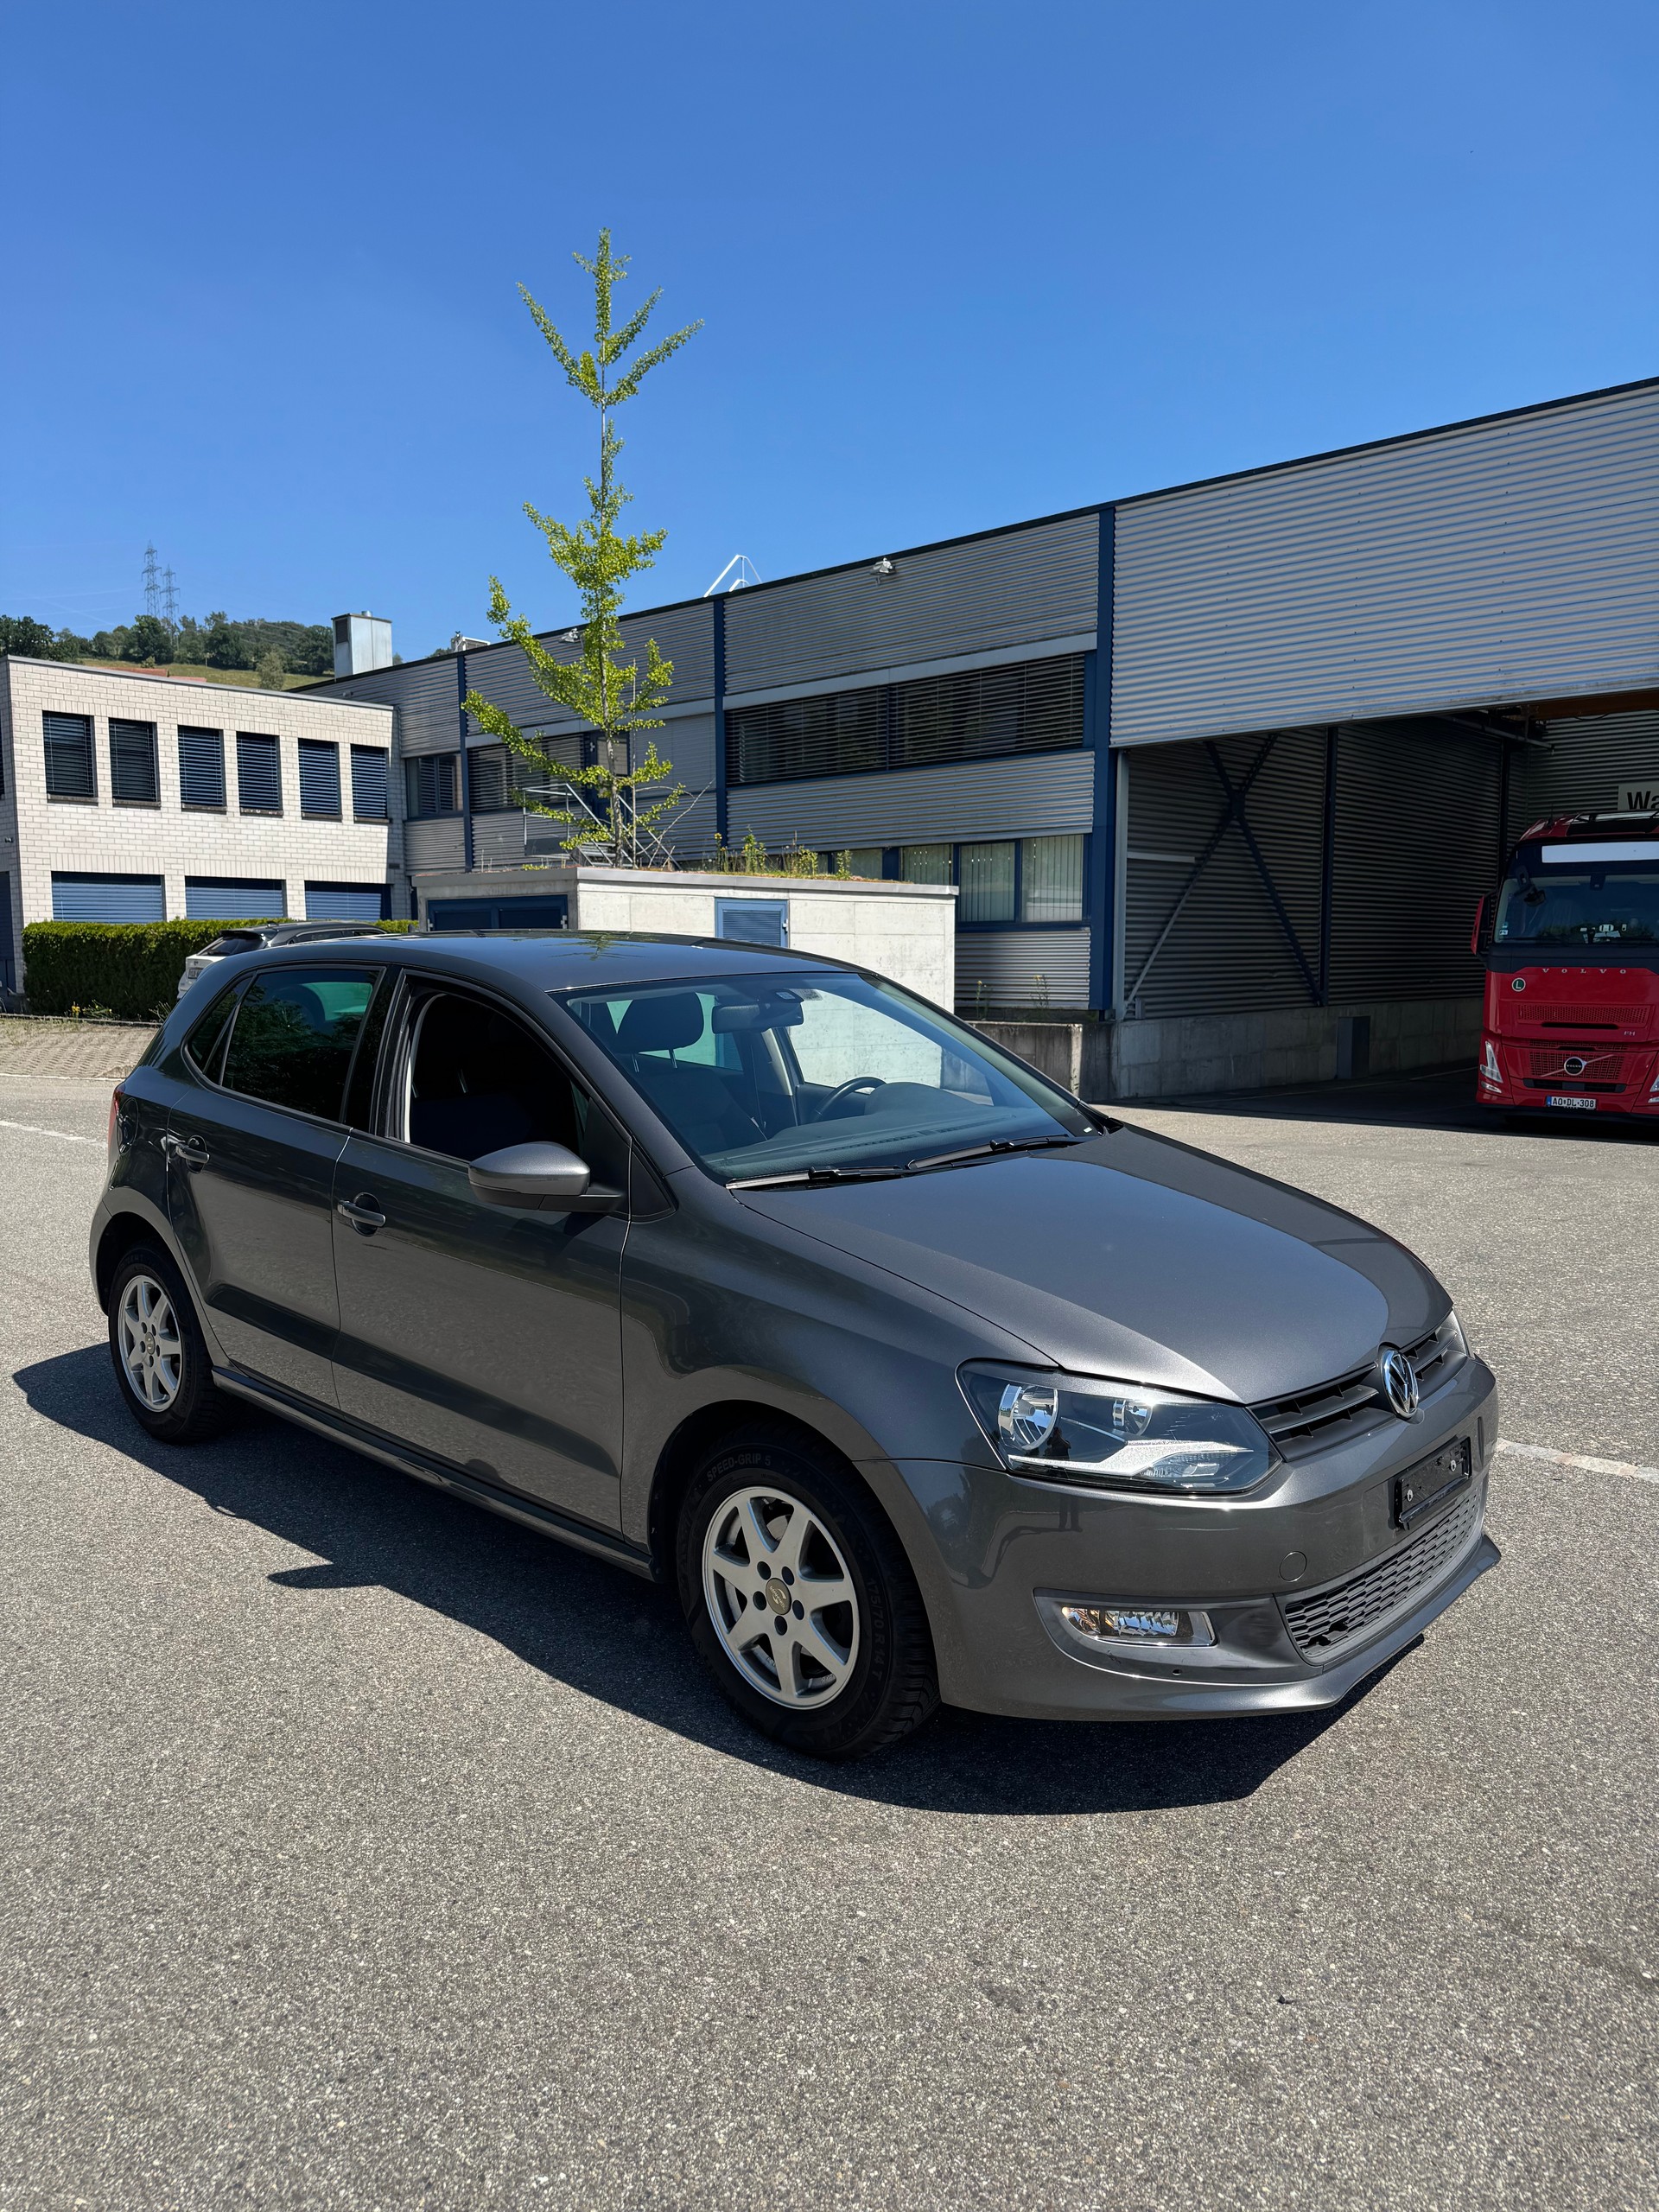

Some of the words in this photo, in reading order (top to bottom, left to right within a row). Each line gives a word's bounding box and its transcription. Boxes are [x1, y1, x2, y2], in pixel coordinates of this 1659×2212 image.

[706, 1452, 762, 1482] SPEED-GRIP
[764, 1455, 772, 1466] 5
[866, 1578, 885, 1630] 175/70
